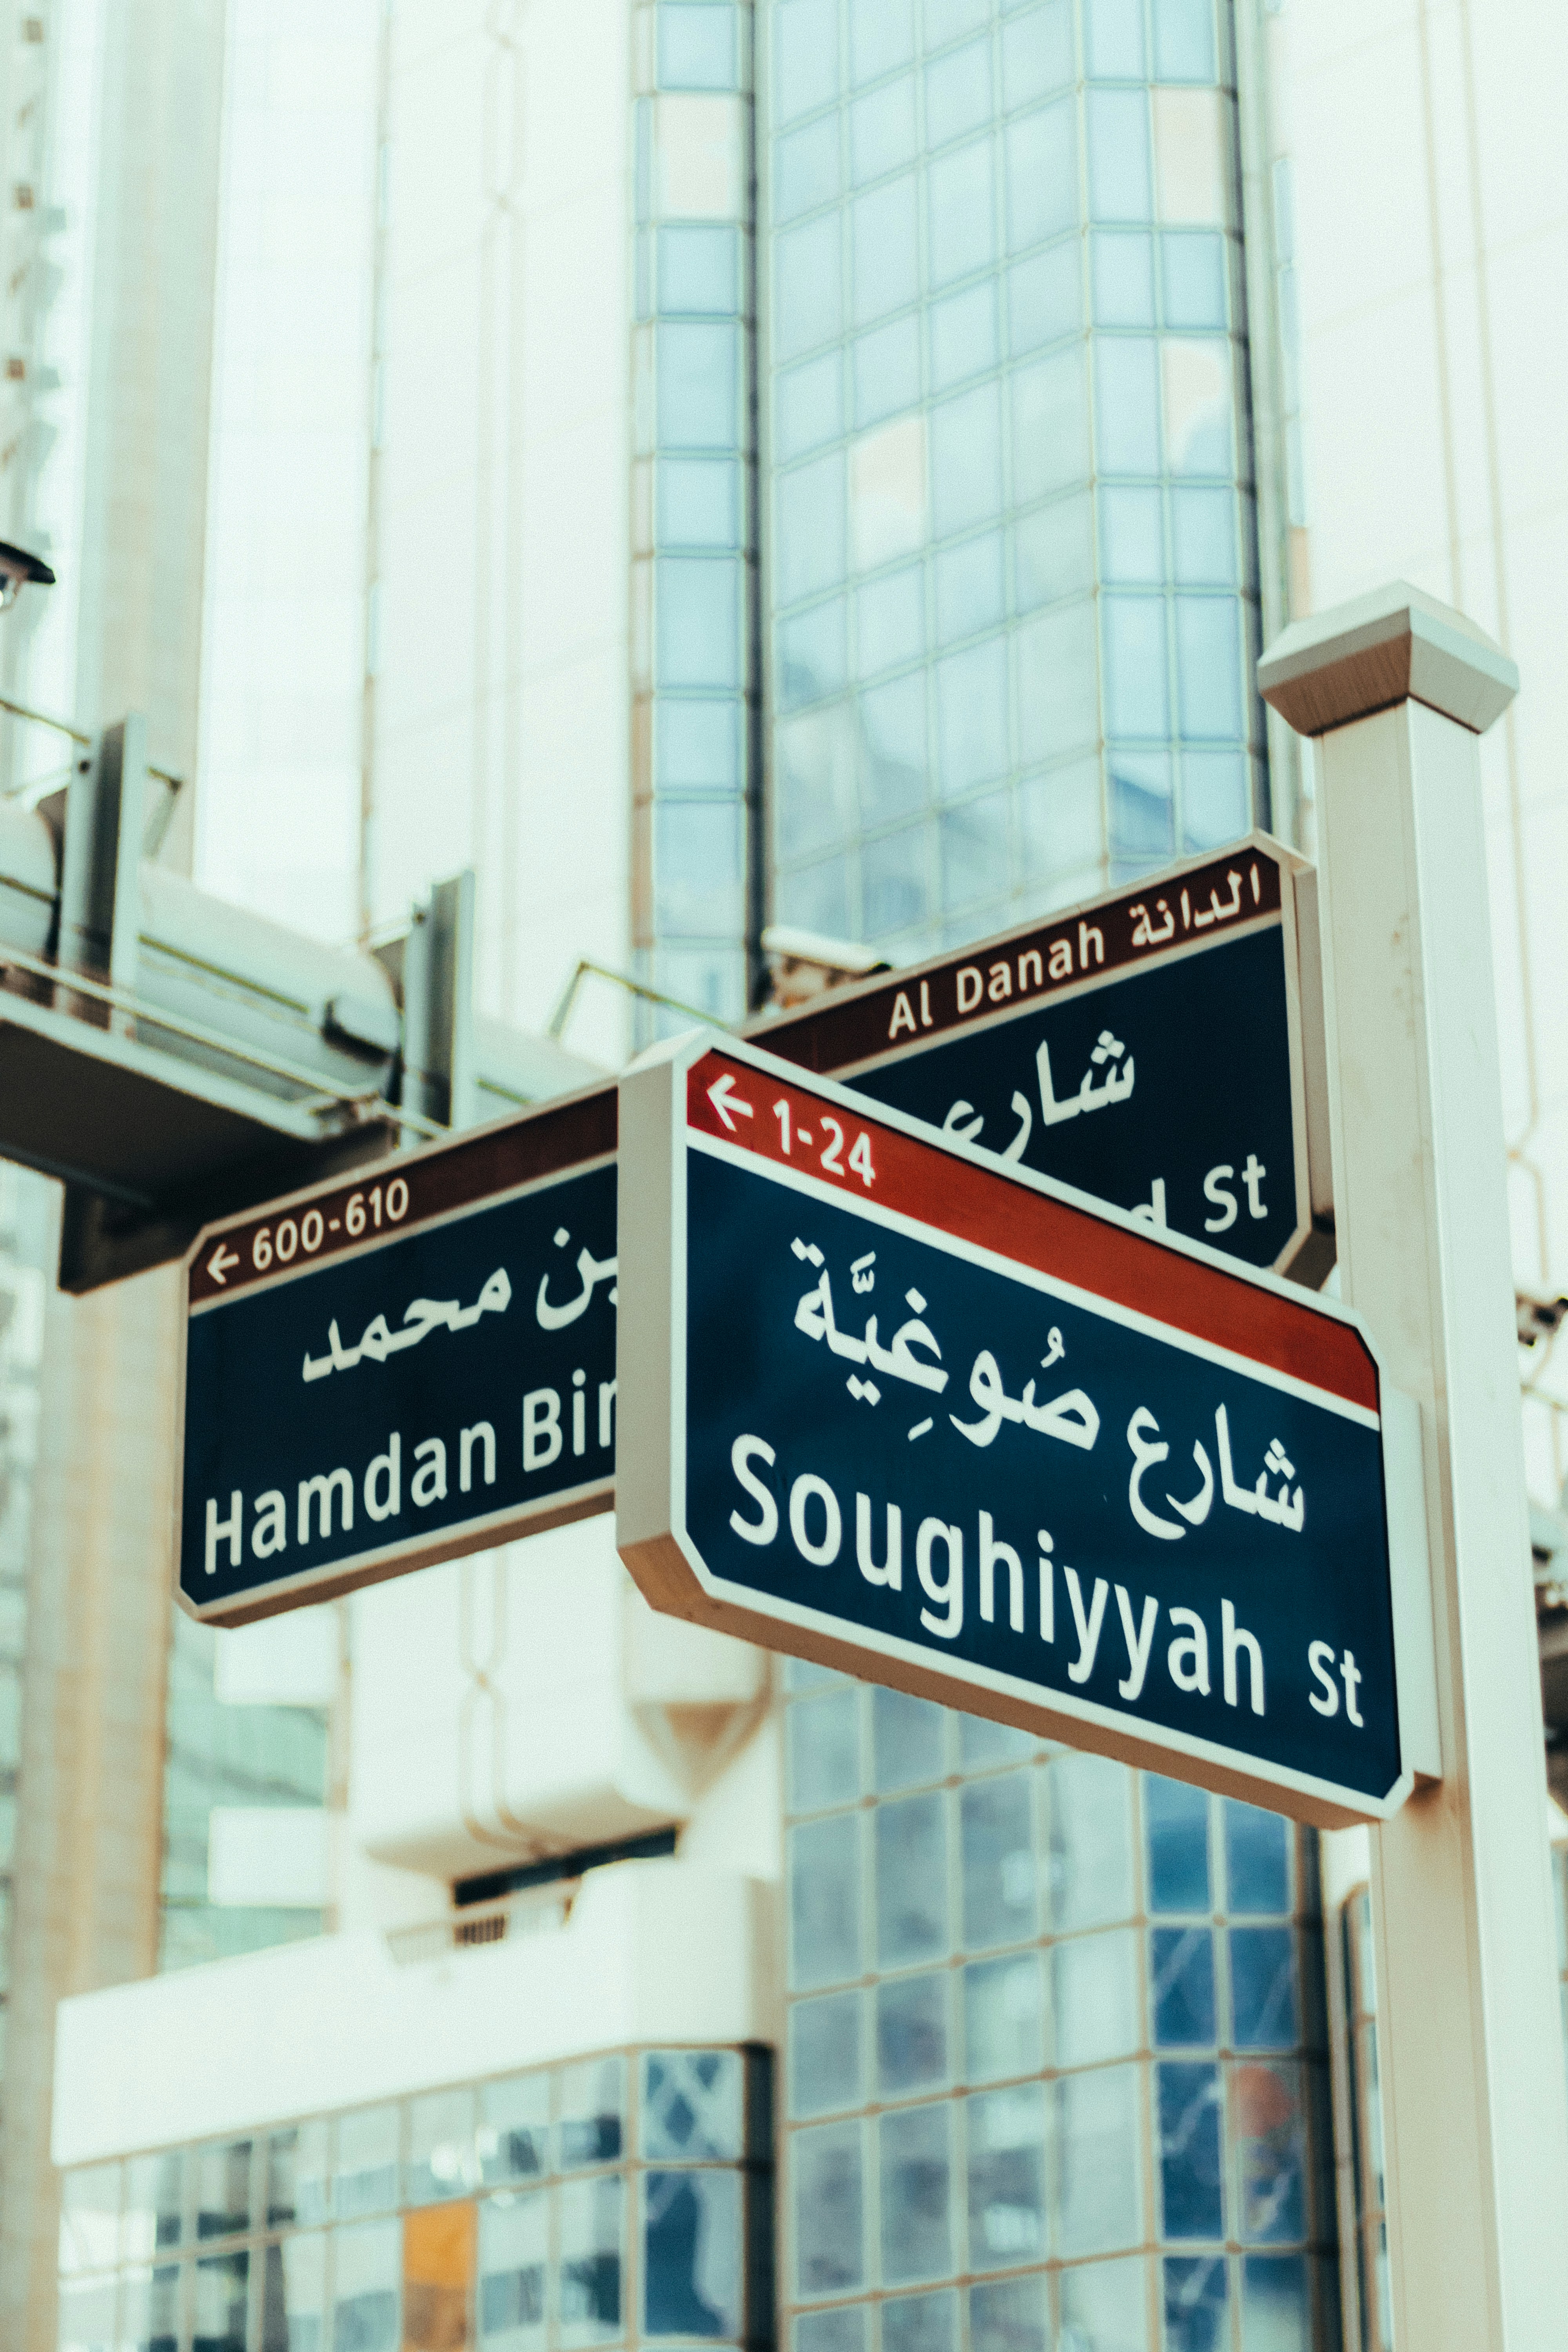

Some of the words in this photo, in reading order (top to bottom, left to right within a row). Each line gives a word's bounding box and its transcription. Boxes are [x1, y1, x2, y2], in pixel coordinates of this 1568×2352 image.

[1129, 864, 1261, 946] الدانة
[888, 981, 933, 1039] Al
[956, 922, 1105, 1013] Danah
[772, 1098, 877, 1189] 1-24
[252, 1178, 409, 1270] 600-610
[205, 1421, 496, 1575] Hamdan
[1203, 1154, 1268, 1233] St
[302, 1267, 512, 1382] محمد
[1126, 1403, 1305, 1540] شارع
[729, 1434, 1265, 1716] Soughiyyah
[1308, 1640, 1364, 1728] St
